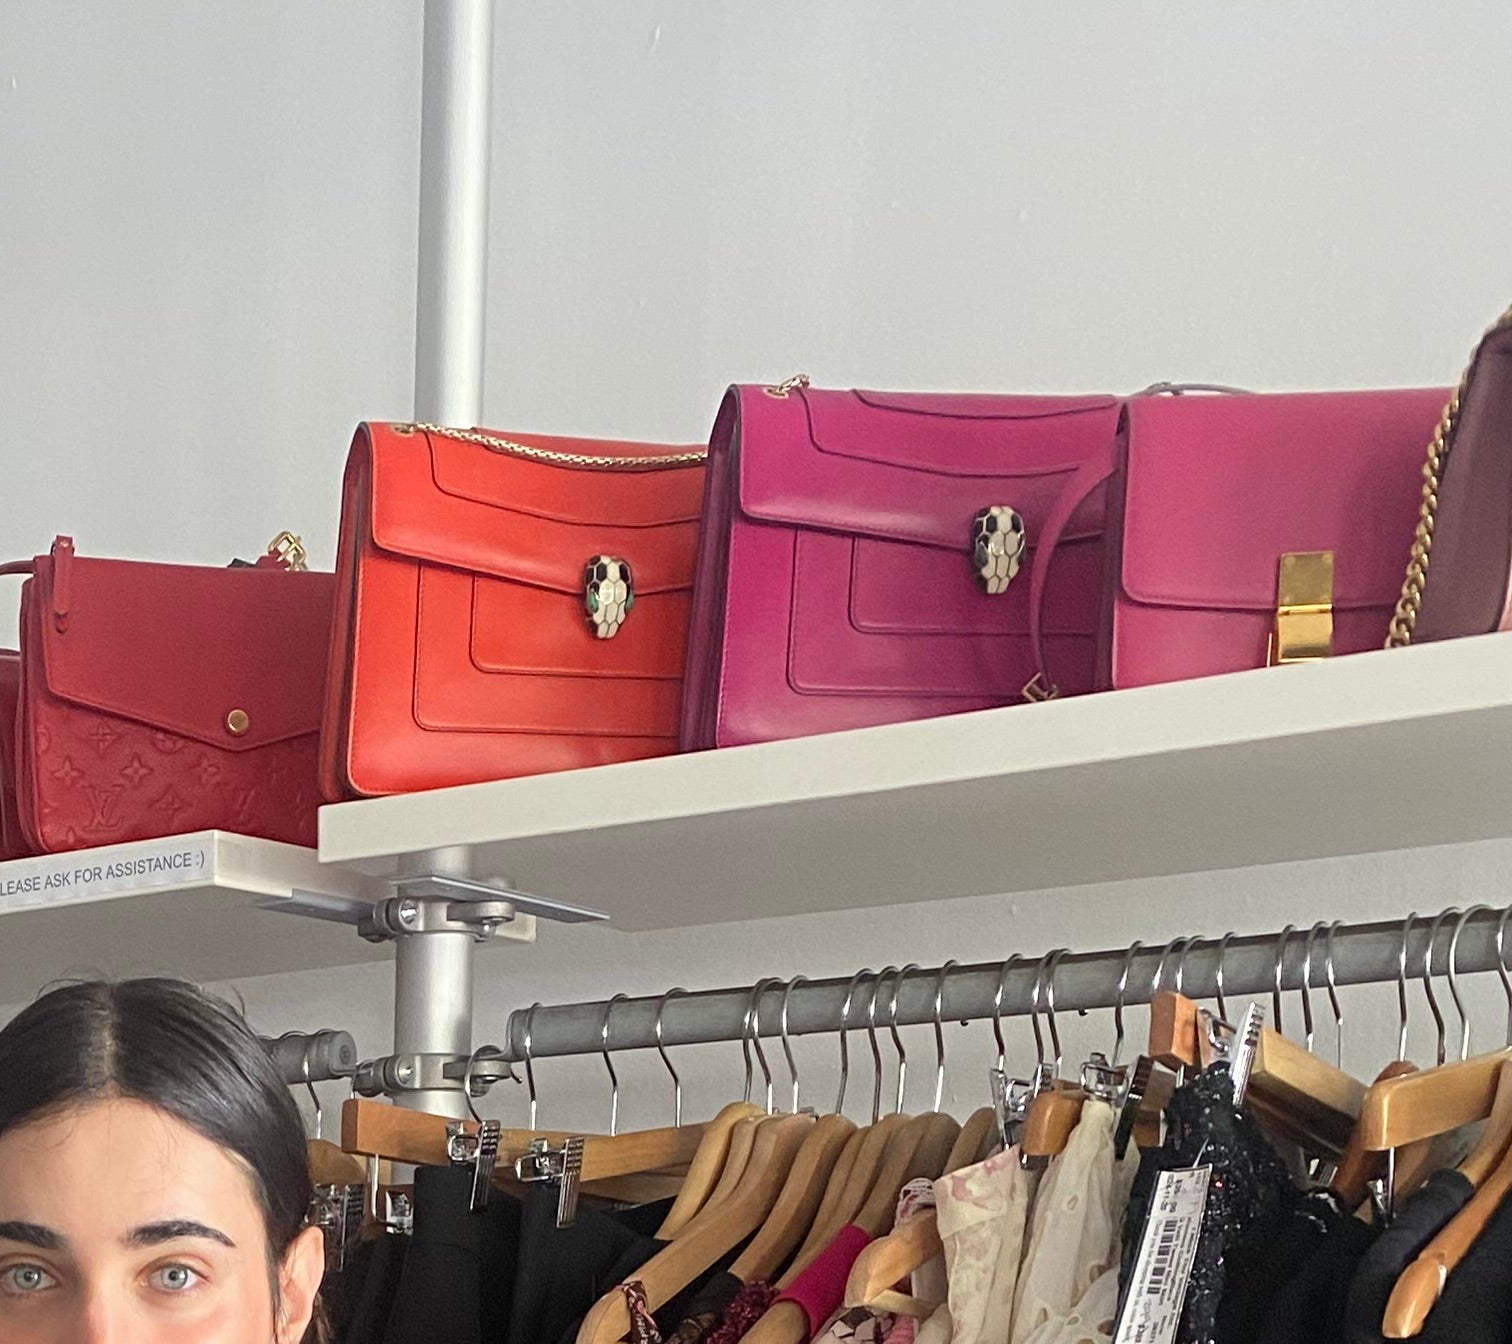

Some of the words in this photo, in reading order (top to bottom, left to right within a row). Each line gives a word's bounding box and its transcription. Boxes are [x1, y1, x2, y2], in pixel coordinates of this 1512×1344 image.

[44, 871, 71, 889] ASK
[74, 866, 102, 883] FOR
[106, 852, 192, 880] ASSISTANCE
